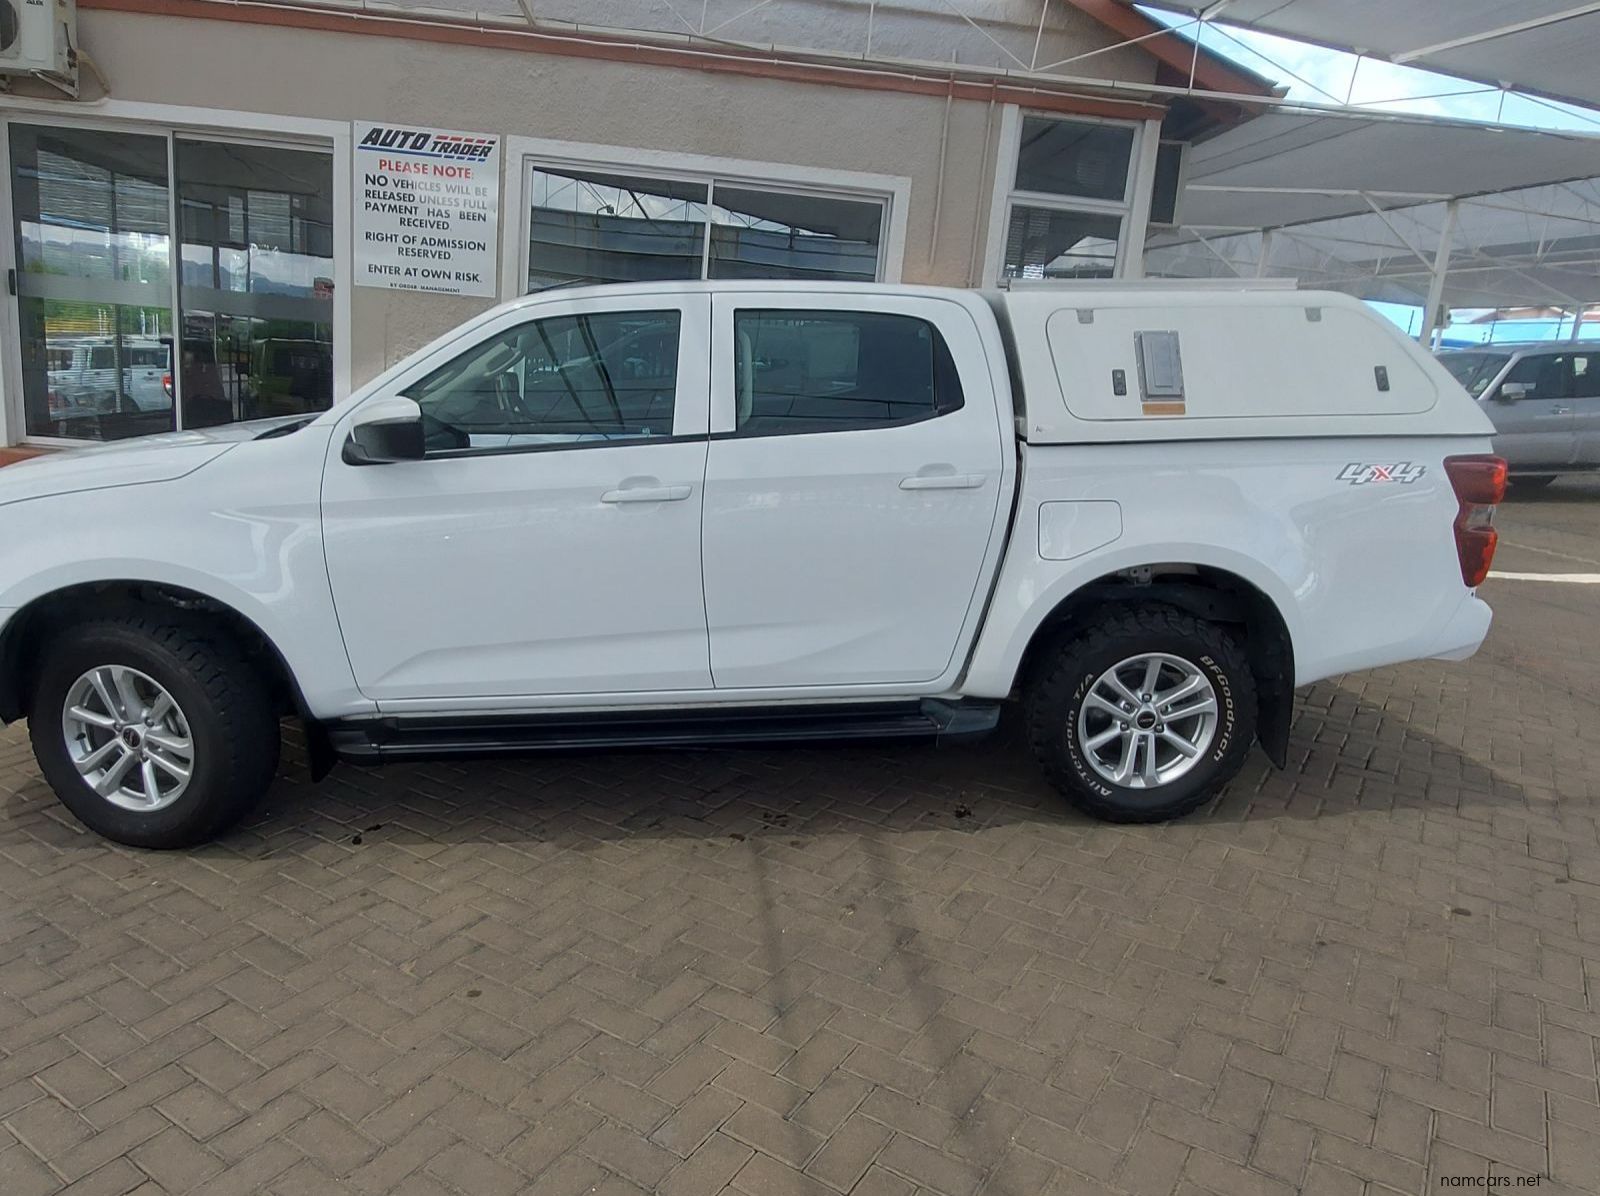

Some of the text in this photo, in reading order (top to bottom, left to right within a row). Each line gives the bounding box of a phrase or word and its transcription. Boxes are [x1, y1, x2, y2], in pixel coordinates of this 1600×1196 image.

[360, 127, 493, 158] AUTO TRADER
[379, 159, 429, 174] PLEASE
[365, 173, 488, 197] NO VEHICLES WILL BE
[365, 189, 488, 210] RELEASED UNLESS FULL
[365, 202, 487, 222] PAYMENT HAS BEEN
[365, 231, 486, 251] RIGHT OF ADMISSION
[368, 264, 482, 283] ENTER AT OWN RISK.
[1073, 673, 1094, 700] T/A
[1200, 655, 1236, 762] BFGoodrich
